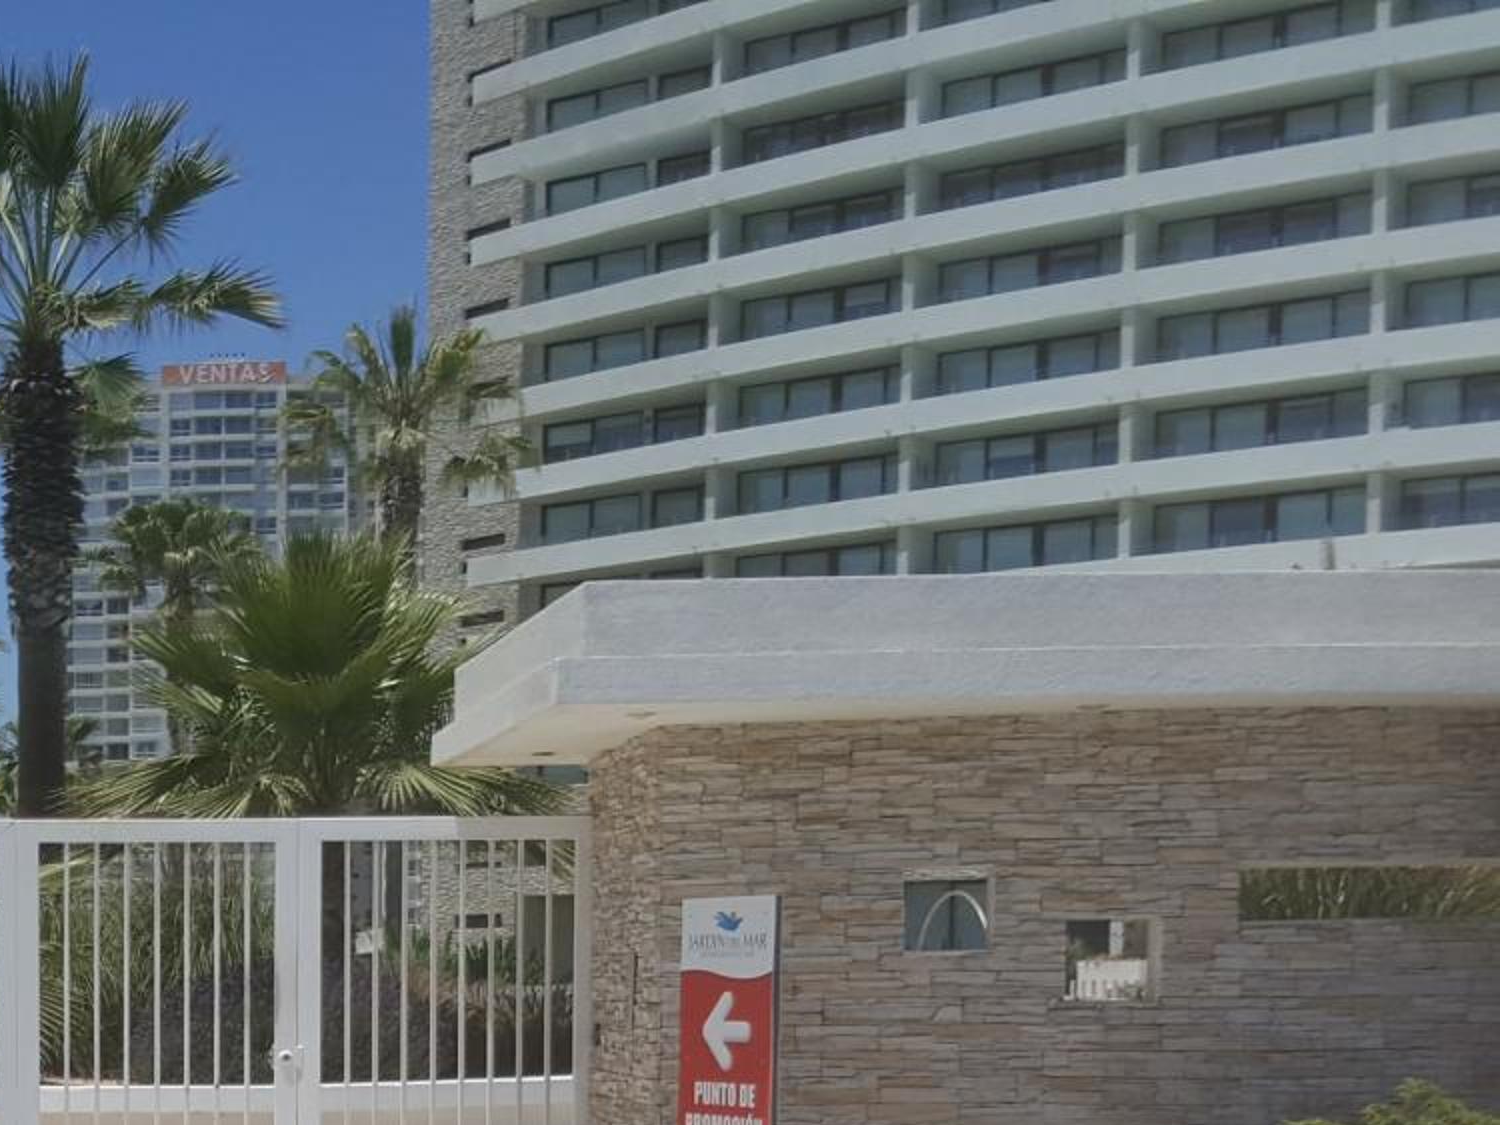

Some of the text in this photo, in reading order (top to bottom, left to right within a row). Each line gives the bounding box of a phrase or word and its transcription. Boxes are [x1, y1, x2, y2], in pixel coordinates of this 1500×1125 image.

[180, 362, 273, 384] VENTAS
[694, 1081, 756, 1108] PUNTO DE
